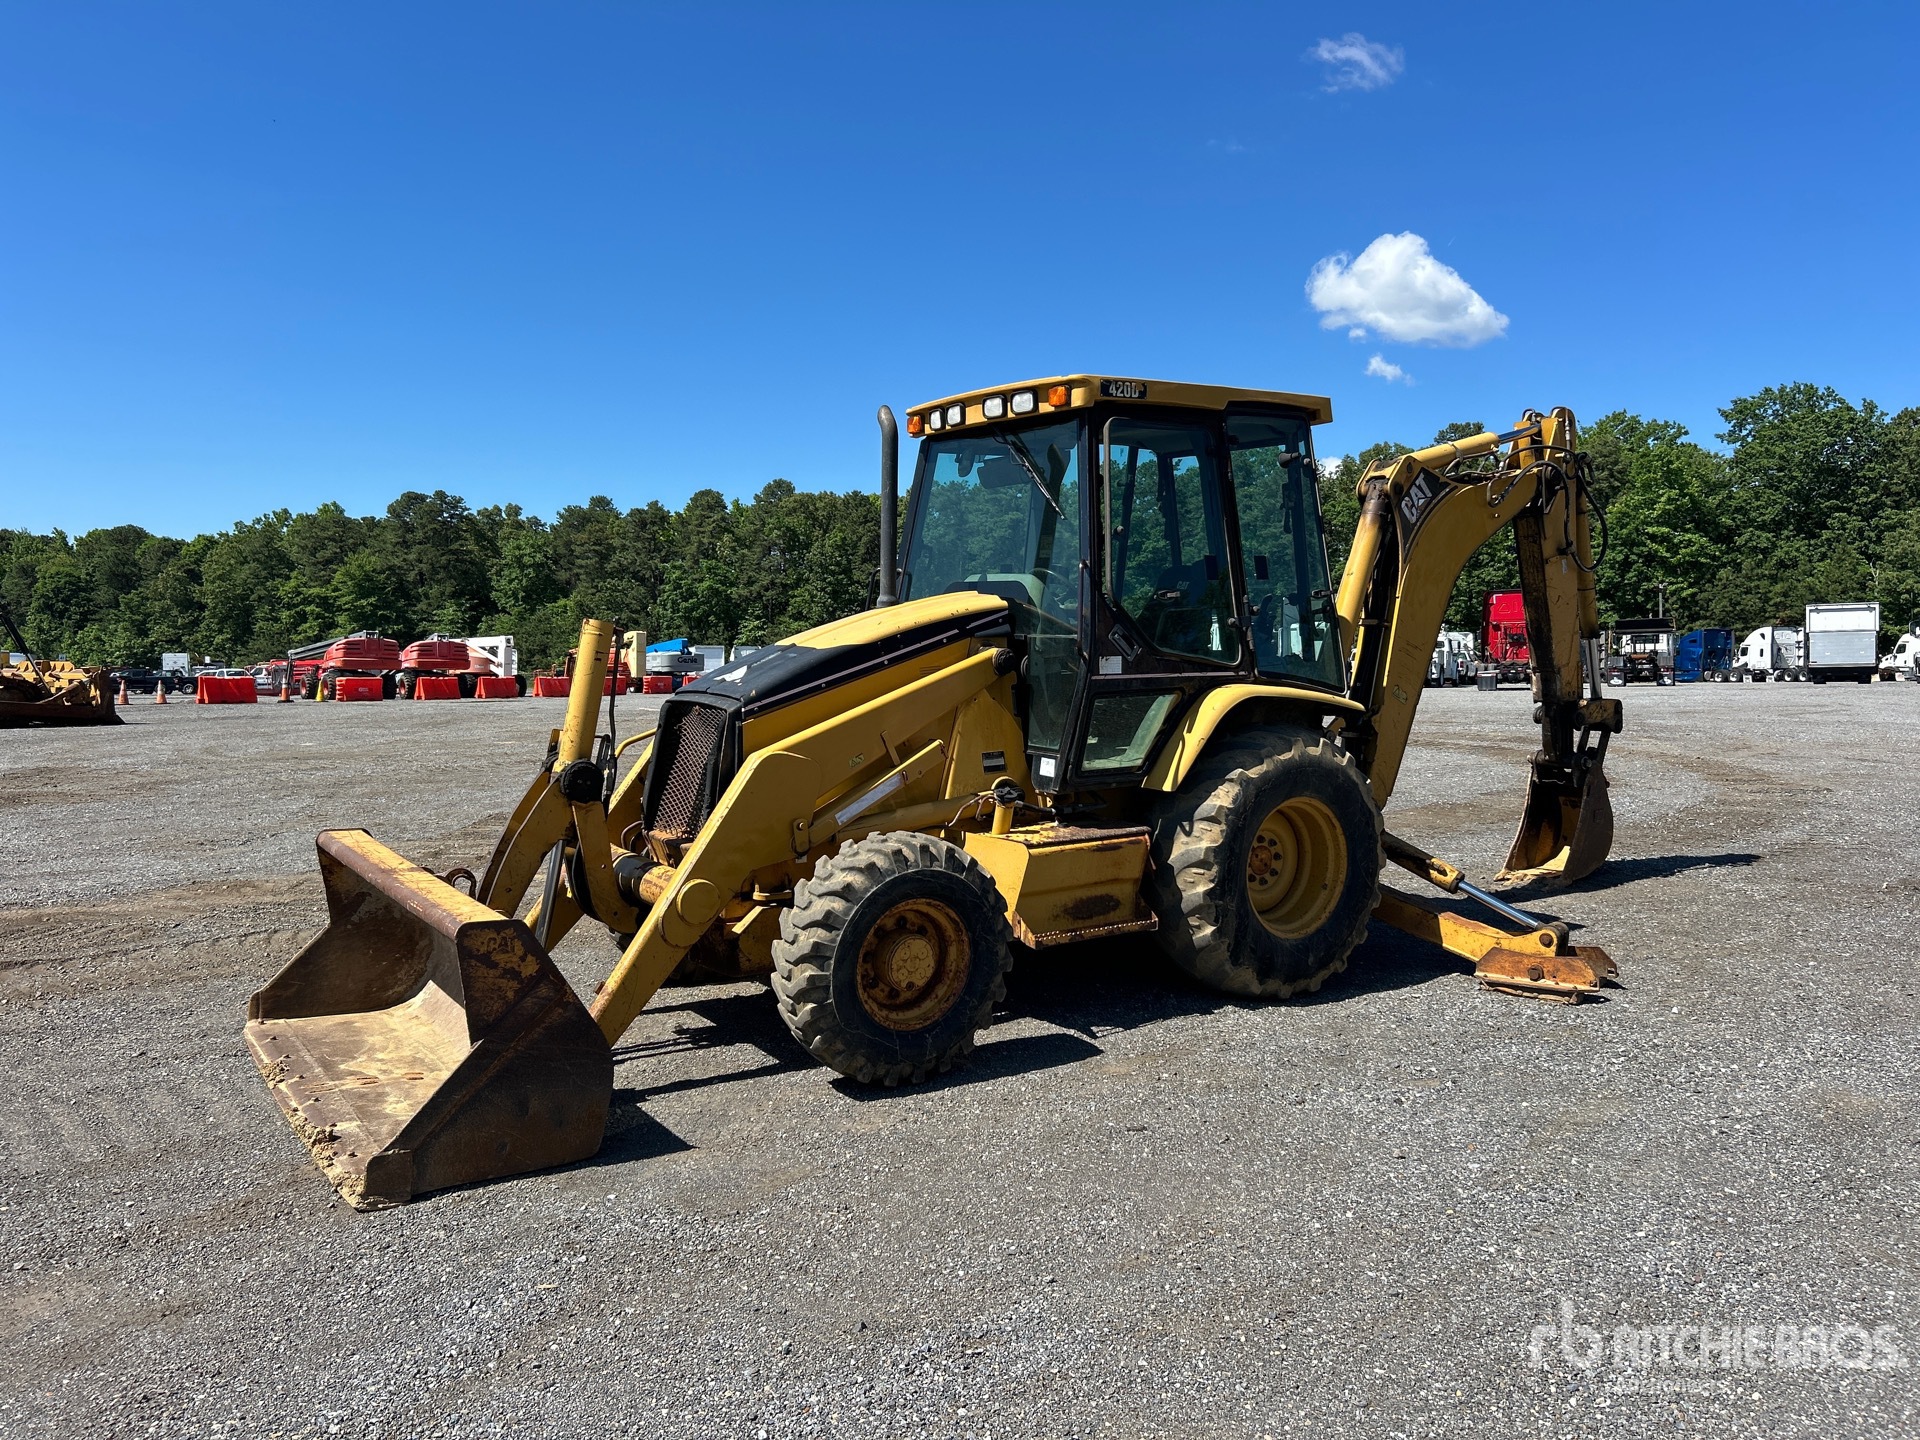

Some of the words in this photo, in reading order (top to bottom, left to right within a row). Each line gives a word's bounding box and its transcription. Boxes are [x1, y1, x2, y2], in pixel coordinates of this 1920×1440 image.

[1109, 382, 1139, 398] 420D
[1401, 472, 1433, 524] CAT
[1177, 581, 1190, 589] CAT
